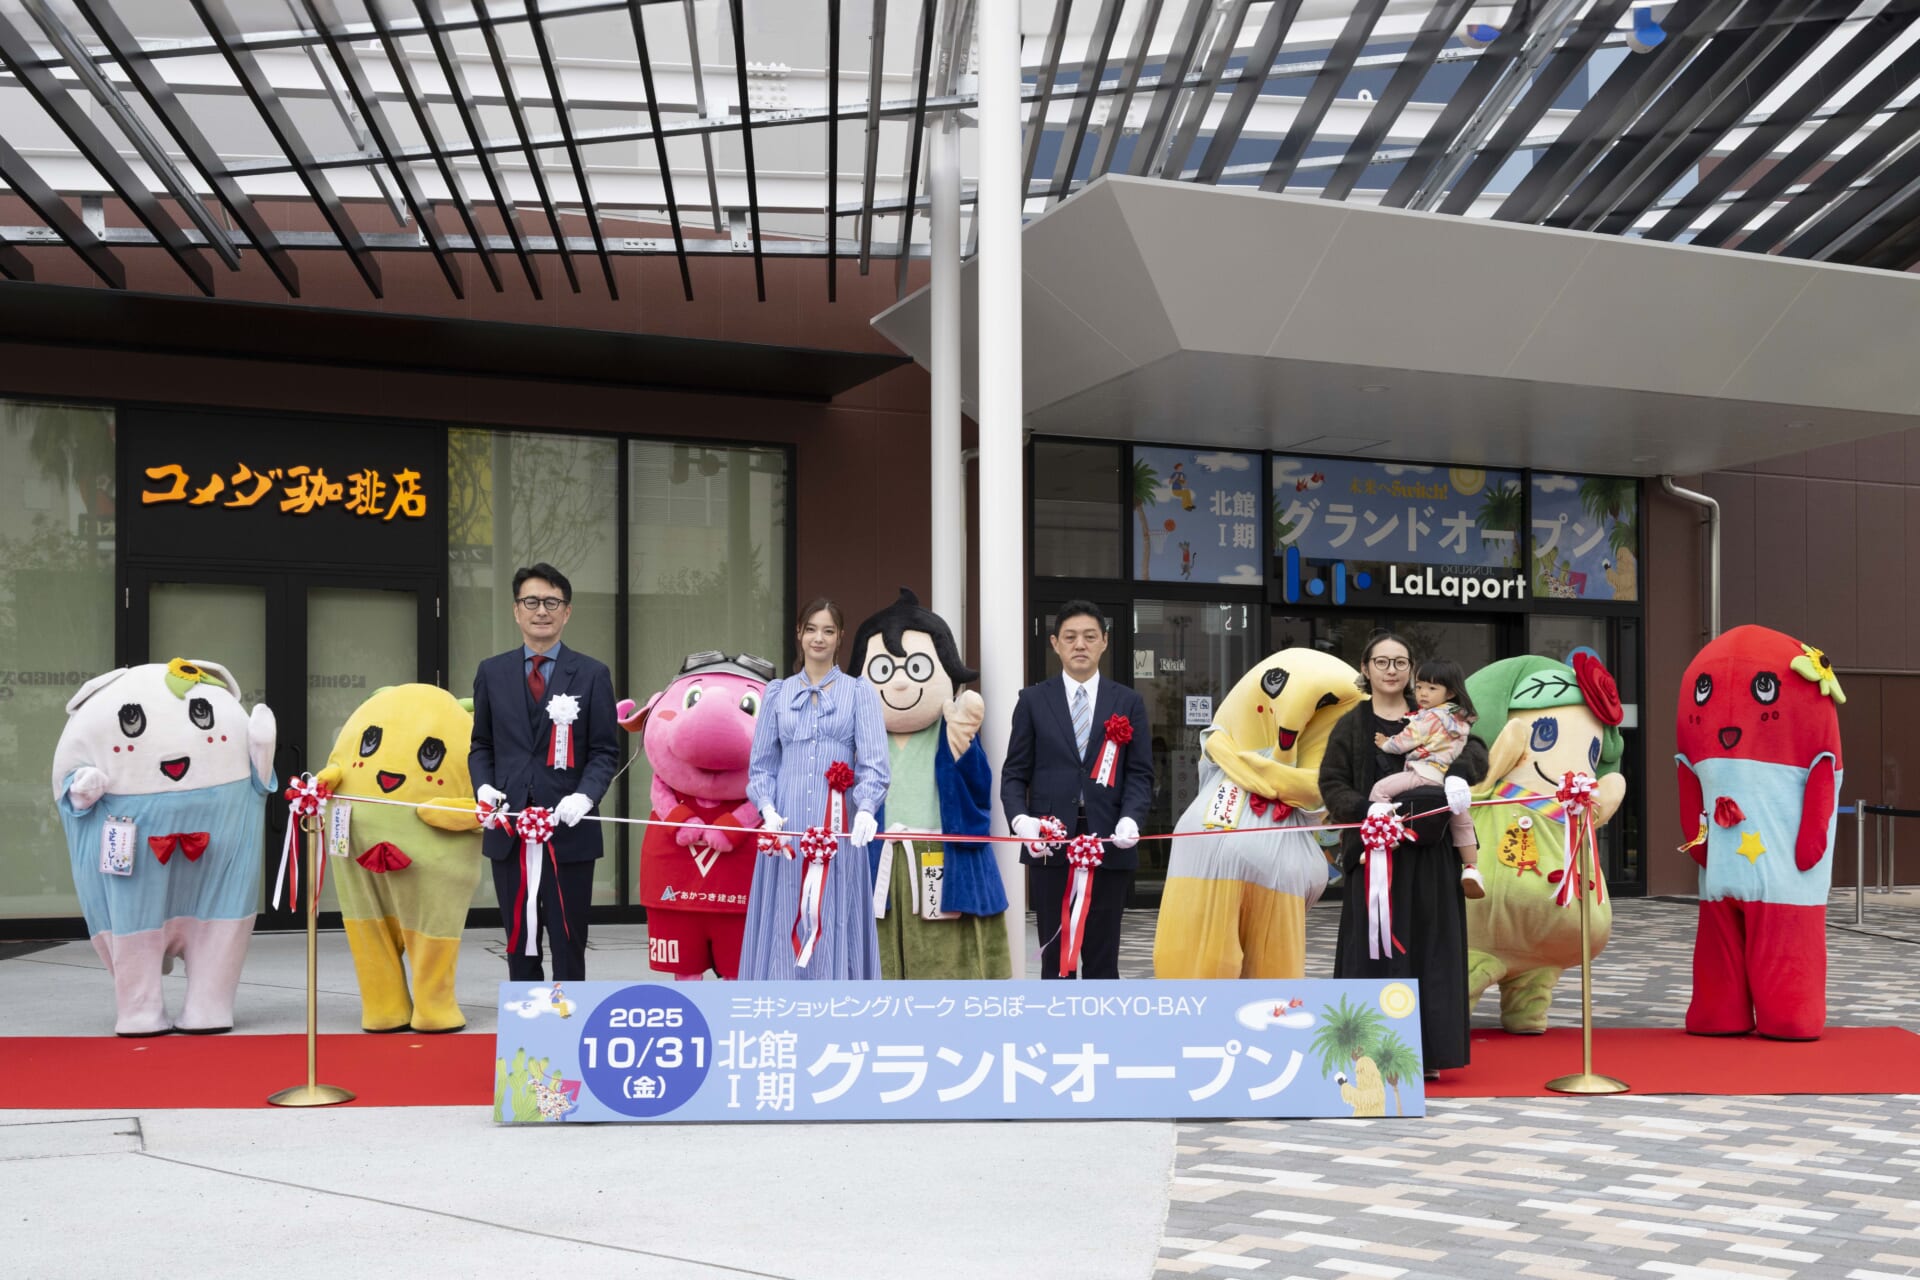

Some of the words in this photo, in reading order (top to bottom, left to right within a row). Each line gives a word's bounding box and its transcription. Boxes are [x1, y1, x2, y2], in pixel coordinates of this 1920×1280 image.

[141, 462, 428, 522] コメダ珈琲店
[1210, 490, 1256, 519] 北館
[1278, 497, 1605, 559] グランドオープン
[1389, 565, 1527, 604] LaLaport
[649, 937, 679, 964] 200
[609, 1008, 684, 1028] 2025
[730, 996, 956, 1019] 三井ショッピングパーク
[963, 995, 1208, 1018] ららぽーとTOKYO-BAY
[583, 1036, 706, 1069] 10/31
[717, 1030, 798, 1070] 北館
[622, 1075, 667, 1100] (金)
[806, 1039, 1304, 1105] グランドオープン
